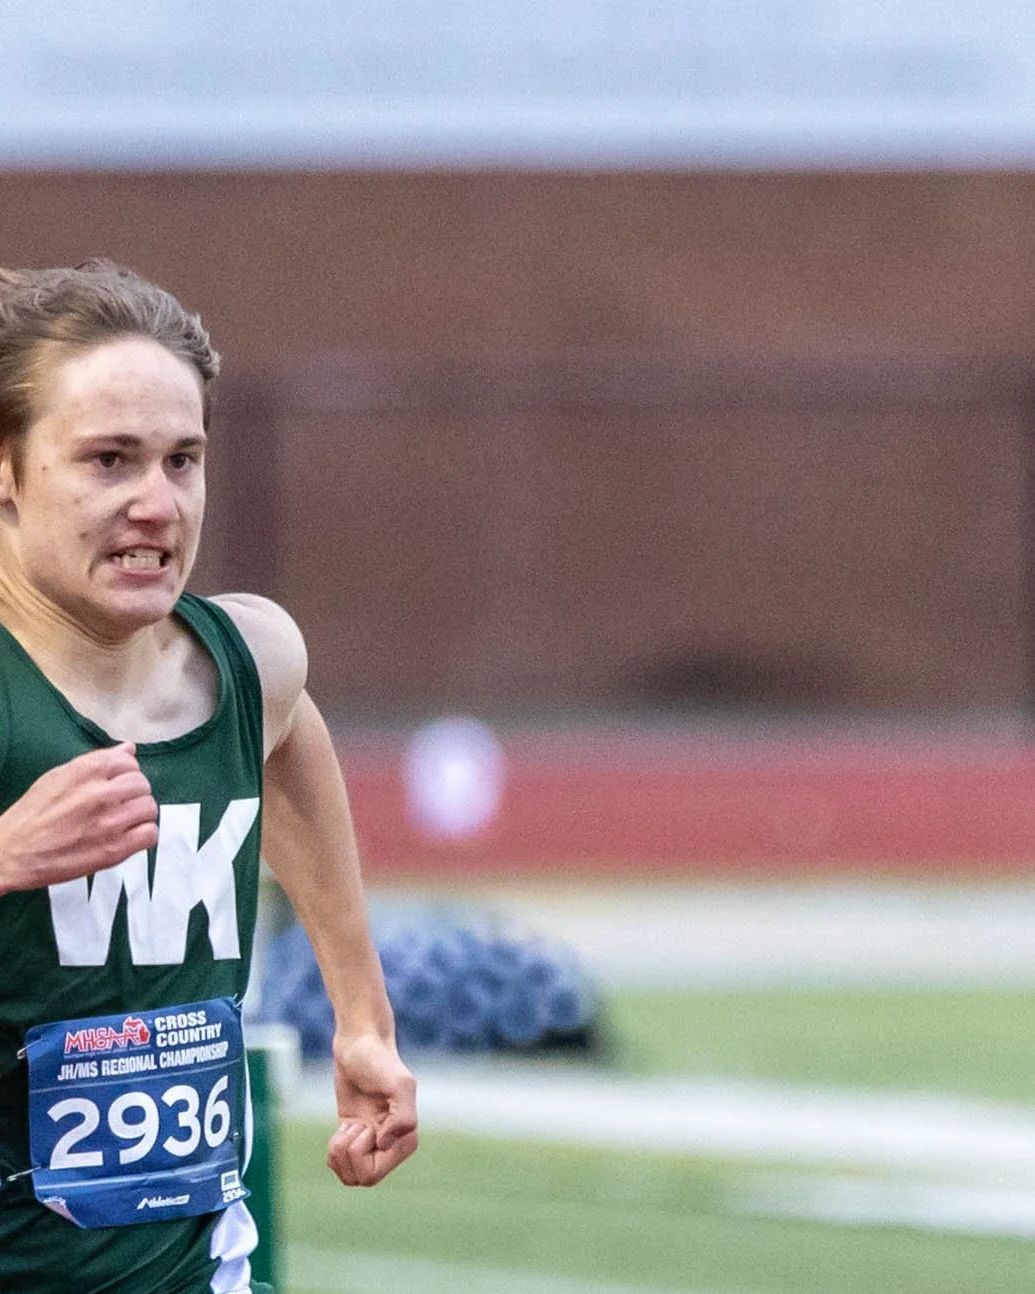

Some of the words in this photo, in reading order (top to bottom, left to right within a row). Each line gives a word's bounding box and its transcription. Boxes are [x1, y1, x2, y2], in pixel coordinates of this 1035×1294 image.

[47, 797, 260, 967] WK
[154, 1010, 207, 1032] CROSS
[156, 1022, 222, 1048] COUNTRY
[57, 1060, 99, 1081] JH/MS
[101, 1053, 158, 1076] REGIONAL
[159, 1041, 230, 1067] CHAMPIONSHIP
[46, 1074, 231, 1171] 2936
